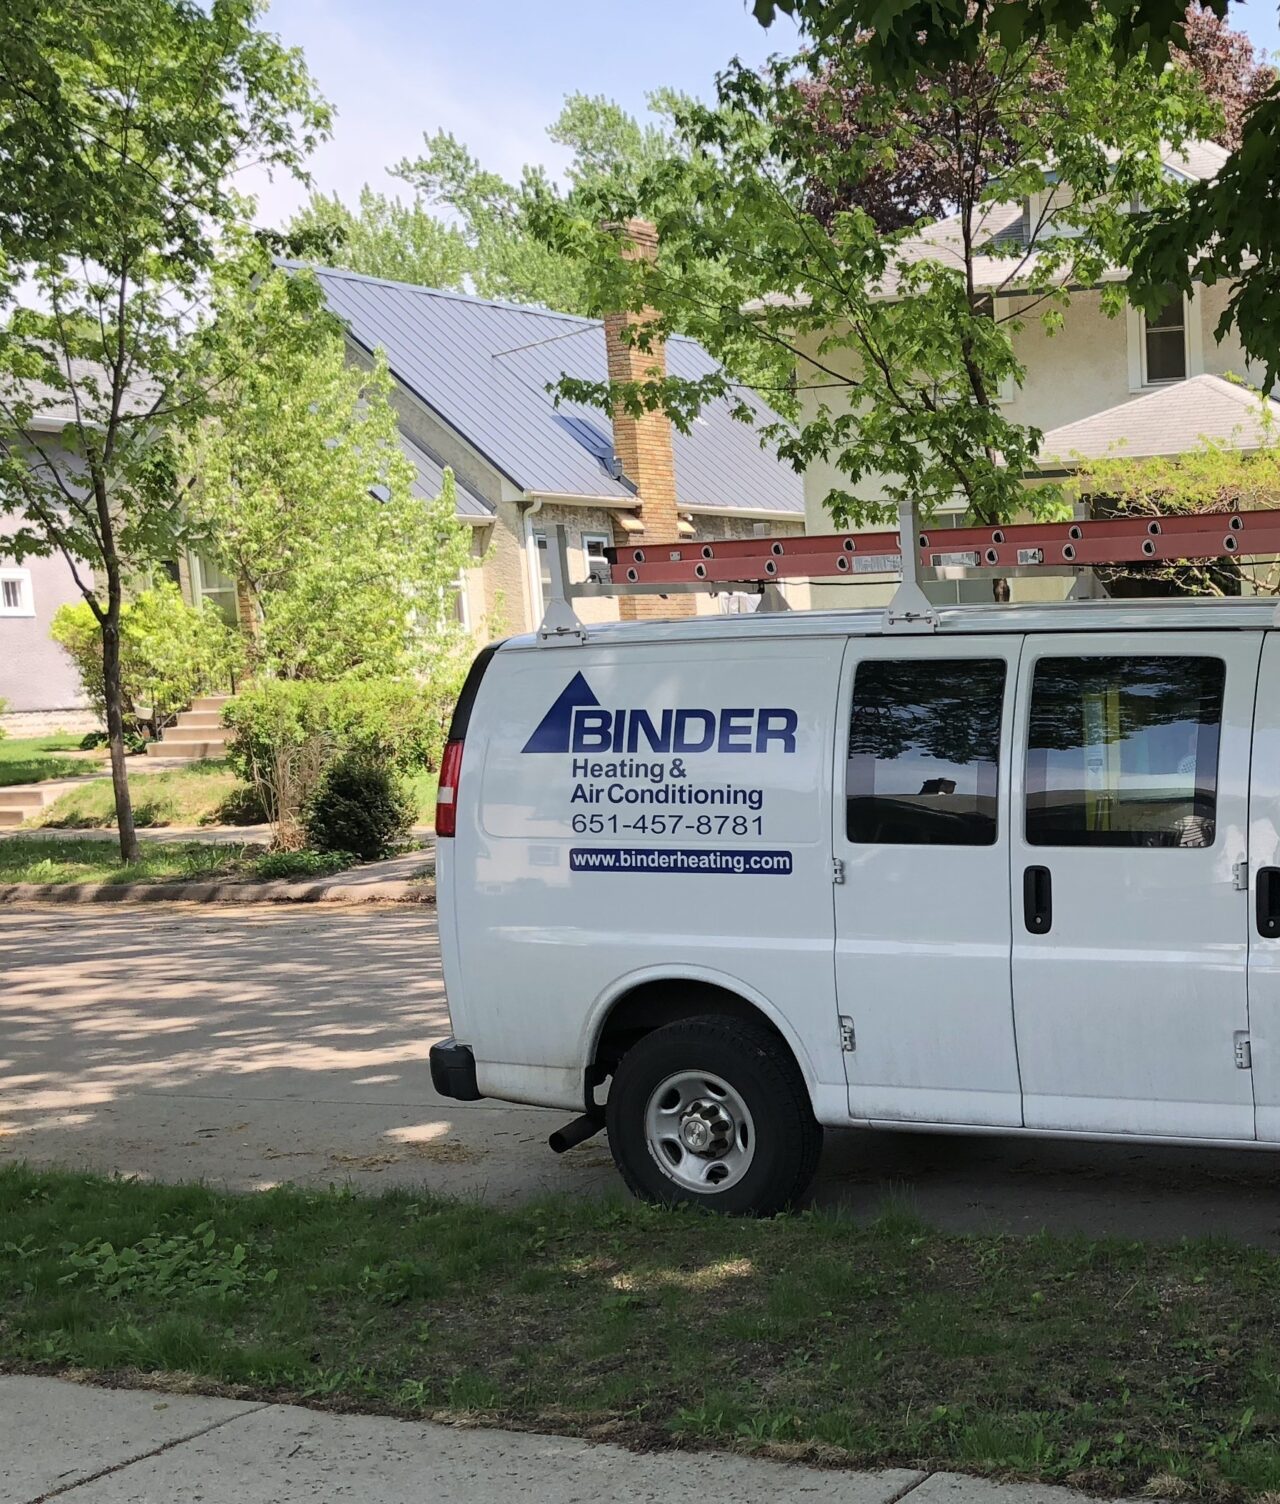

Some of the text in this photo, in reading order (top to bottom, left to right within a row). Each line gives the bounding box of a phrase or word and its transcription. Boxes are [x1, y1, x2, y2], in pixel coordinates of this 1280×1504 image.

[572, 708, 798, 753] BINDER
[572, 758, 687, 783] Heating &
[571, 783, 763, 810] Air Conditioning
[571, 813, 763, 836] 651-457-8781
[572, 850, 790, 872] www.binderheating.com
